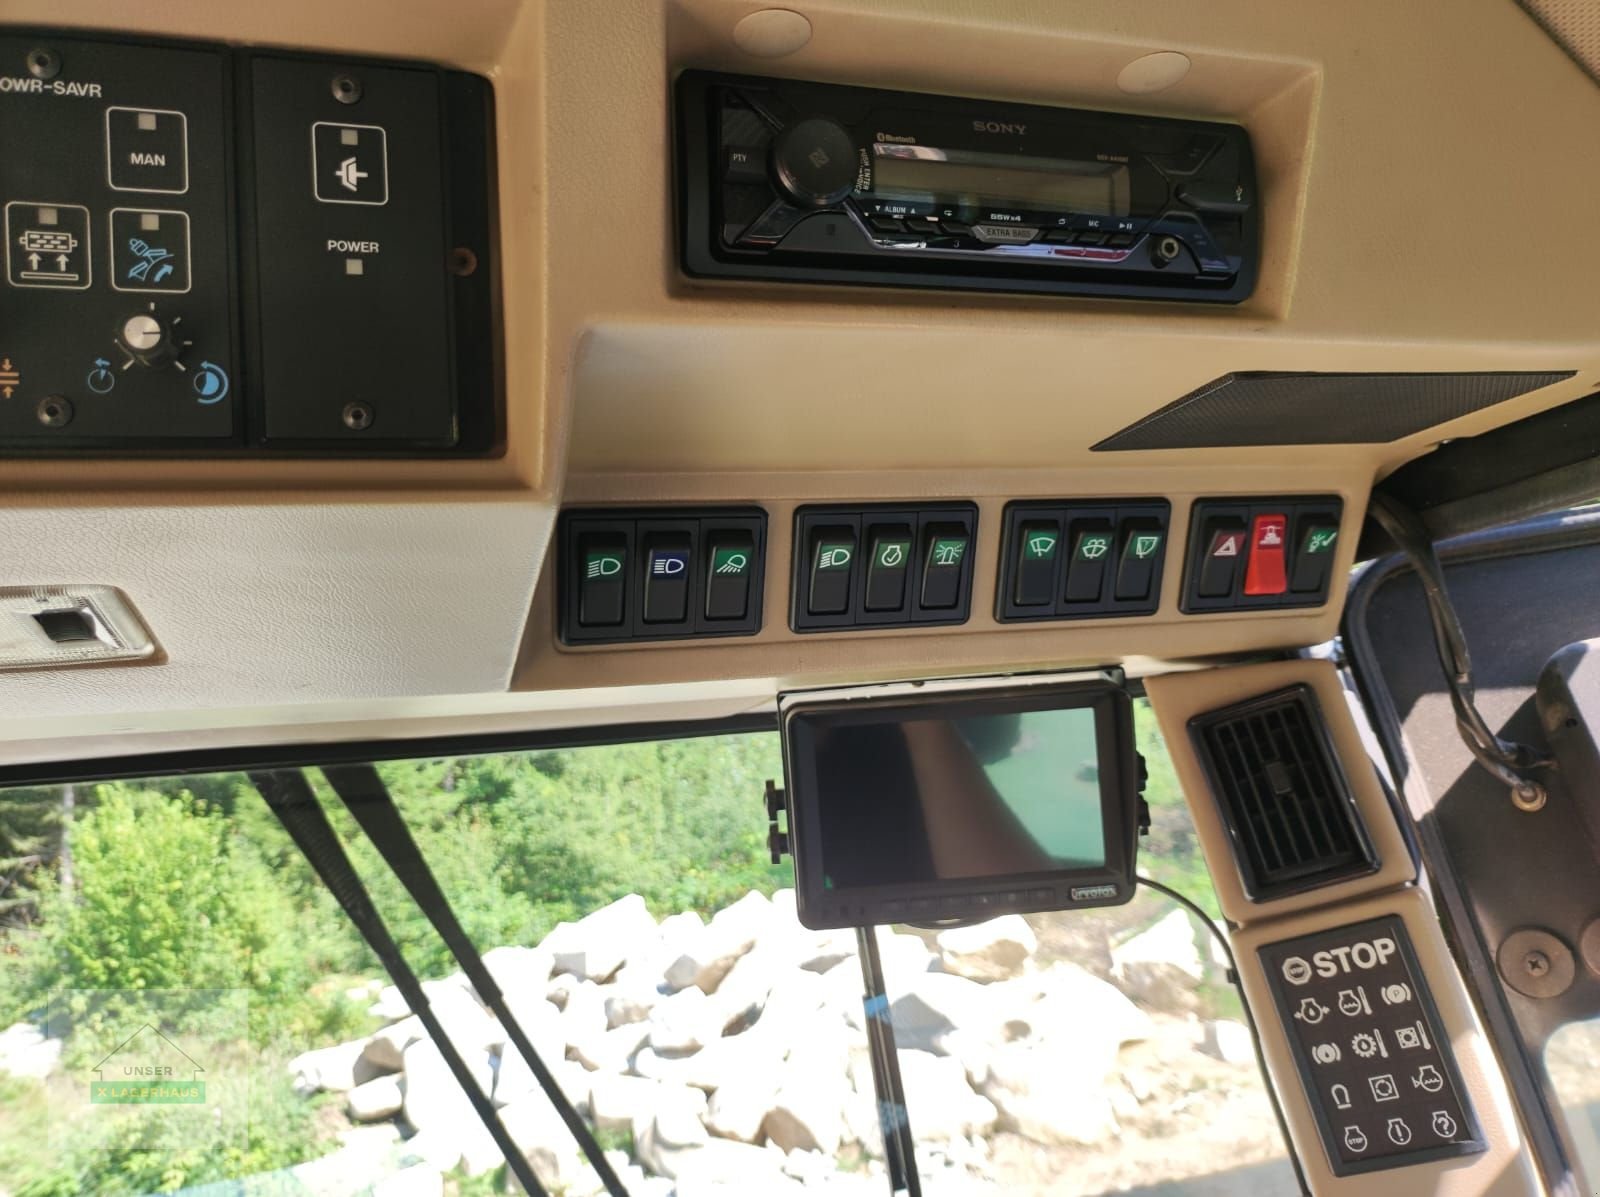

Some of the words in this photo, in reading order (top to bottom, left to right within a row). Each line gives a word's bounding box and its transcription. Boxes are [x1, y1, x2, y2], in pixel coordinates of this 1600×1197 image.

[0, 76, 102, 98] OWR-SAVR
[972, 120, 1027, 135] SONY
[130, 152, 166, 166] MAN
[733, 153, 747, 163] PTY
[862, 168, 871, 191] ENTER
[884, 206, 906, 214] ALBUM
[987, 228, 1010, 238] EXTRA
[327, 239, 380, 254] POWER
[1312, 937, 1396, 978] STOP
